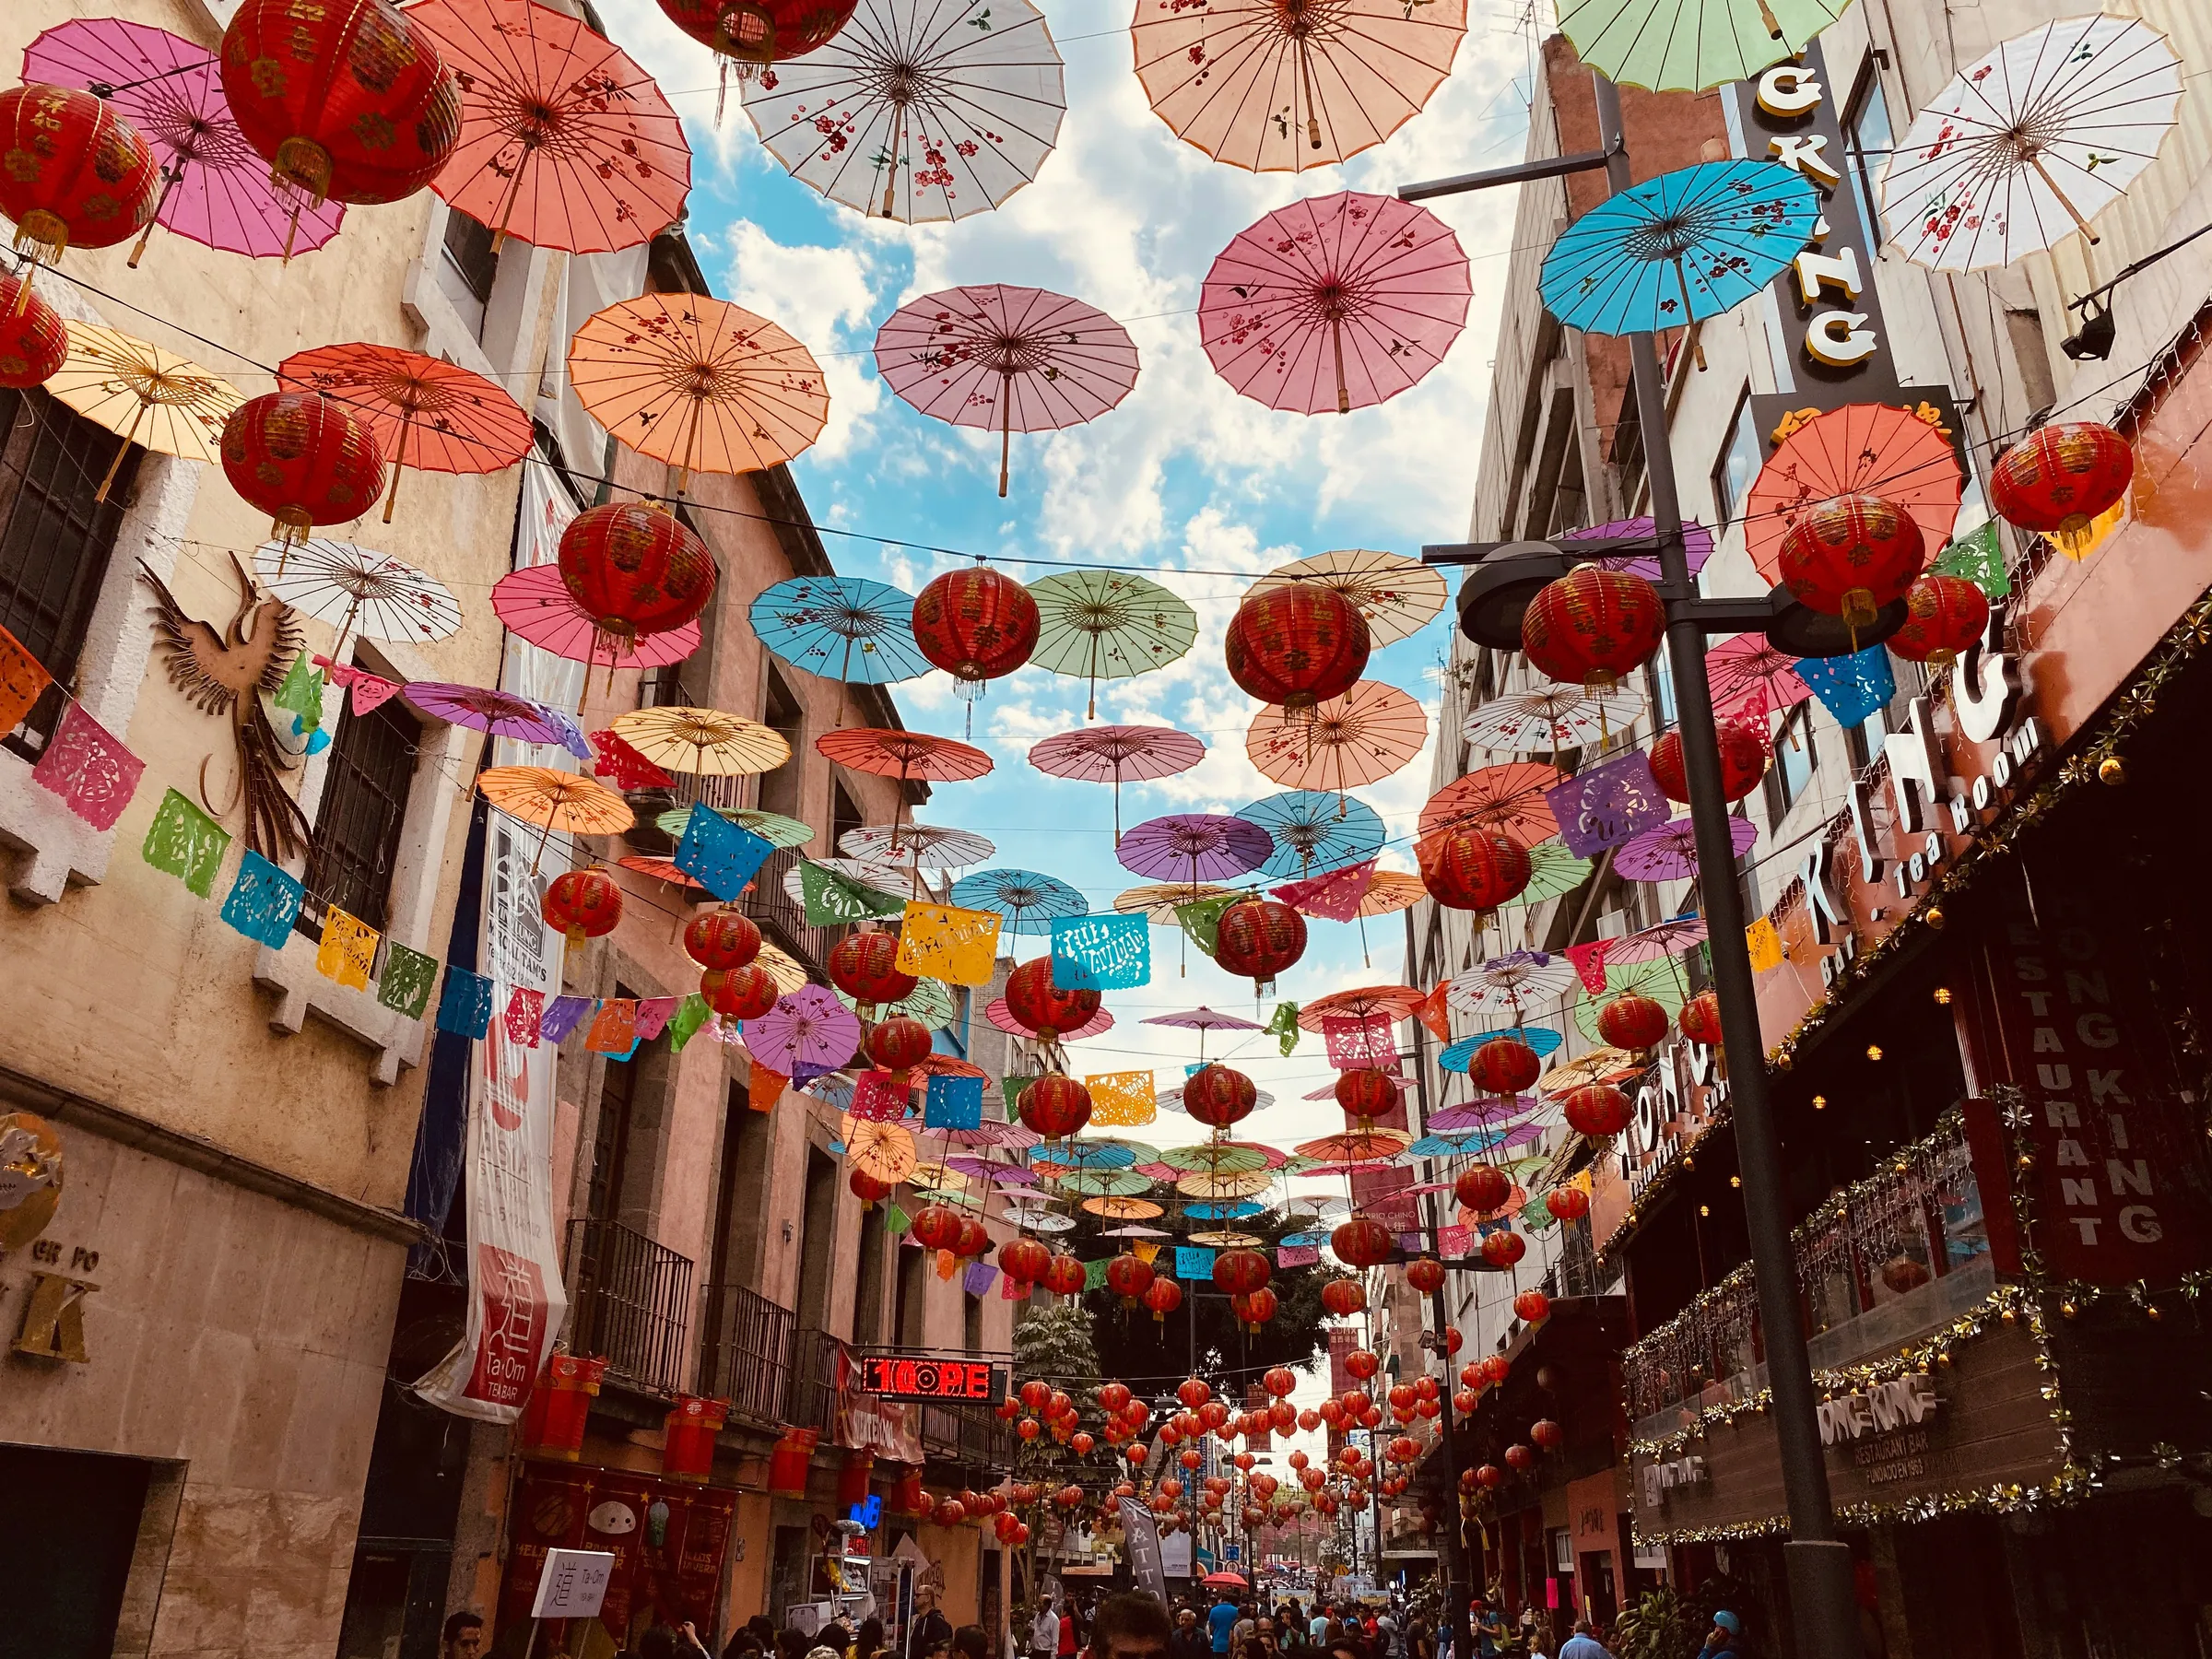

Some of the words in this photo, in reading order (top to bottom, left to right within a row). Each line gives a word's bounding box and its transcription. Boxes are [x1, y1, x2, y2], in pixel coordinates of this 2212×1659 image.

[1819, 932, 1856, 983] Bar
[1893, 831, 1946, 899] Tea
[1950, 716, 2041, 836] Room
[2000, 890, 2103, 1246] ESTAURANT
[2050, 896, 2119, 1049] ONG
[2087, 1068, 2162, 1244] KING
[1388, 1210, 1416, 1219] CHINO
[488, 1382, 502, 1397] TEA
[501, 1383, 518, 1401] BAR
[1817, 1394, 1874, 1446] ONG
[1866, 1372, 1936, 1433] KING
[1854, 1437, 1907, 1465] RESTAURANT
[1908, 1431, 1929, 1454] BAR
